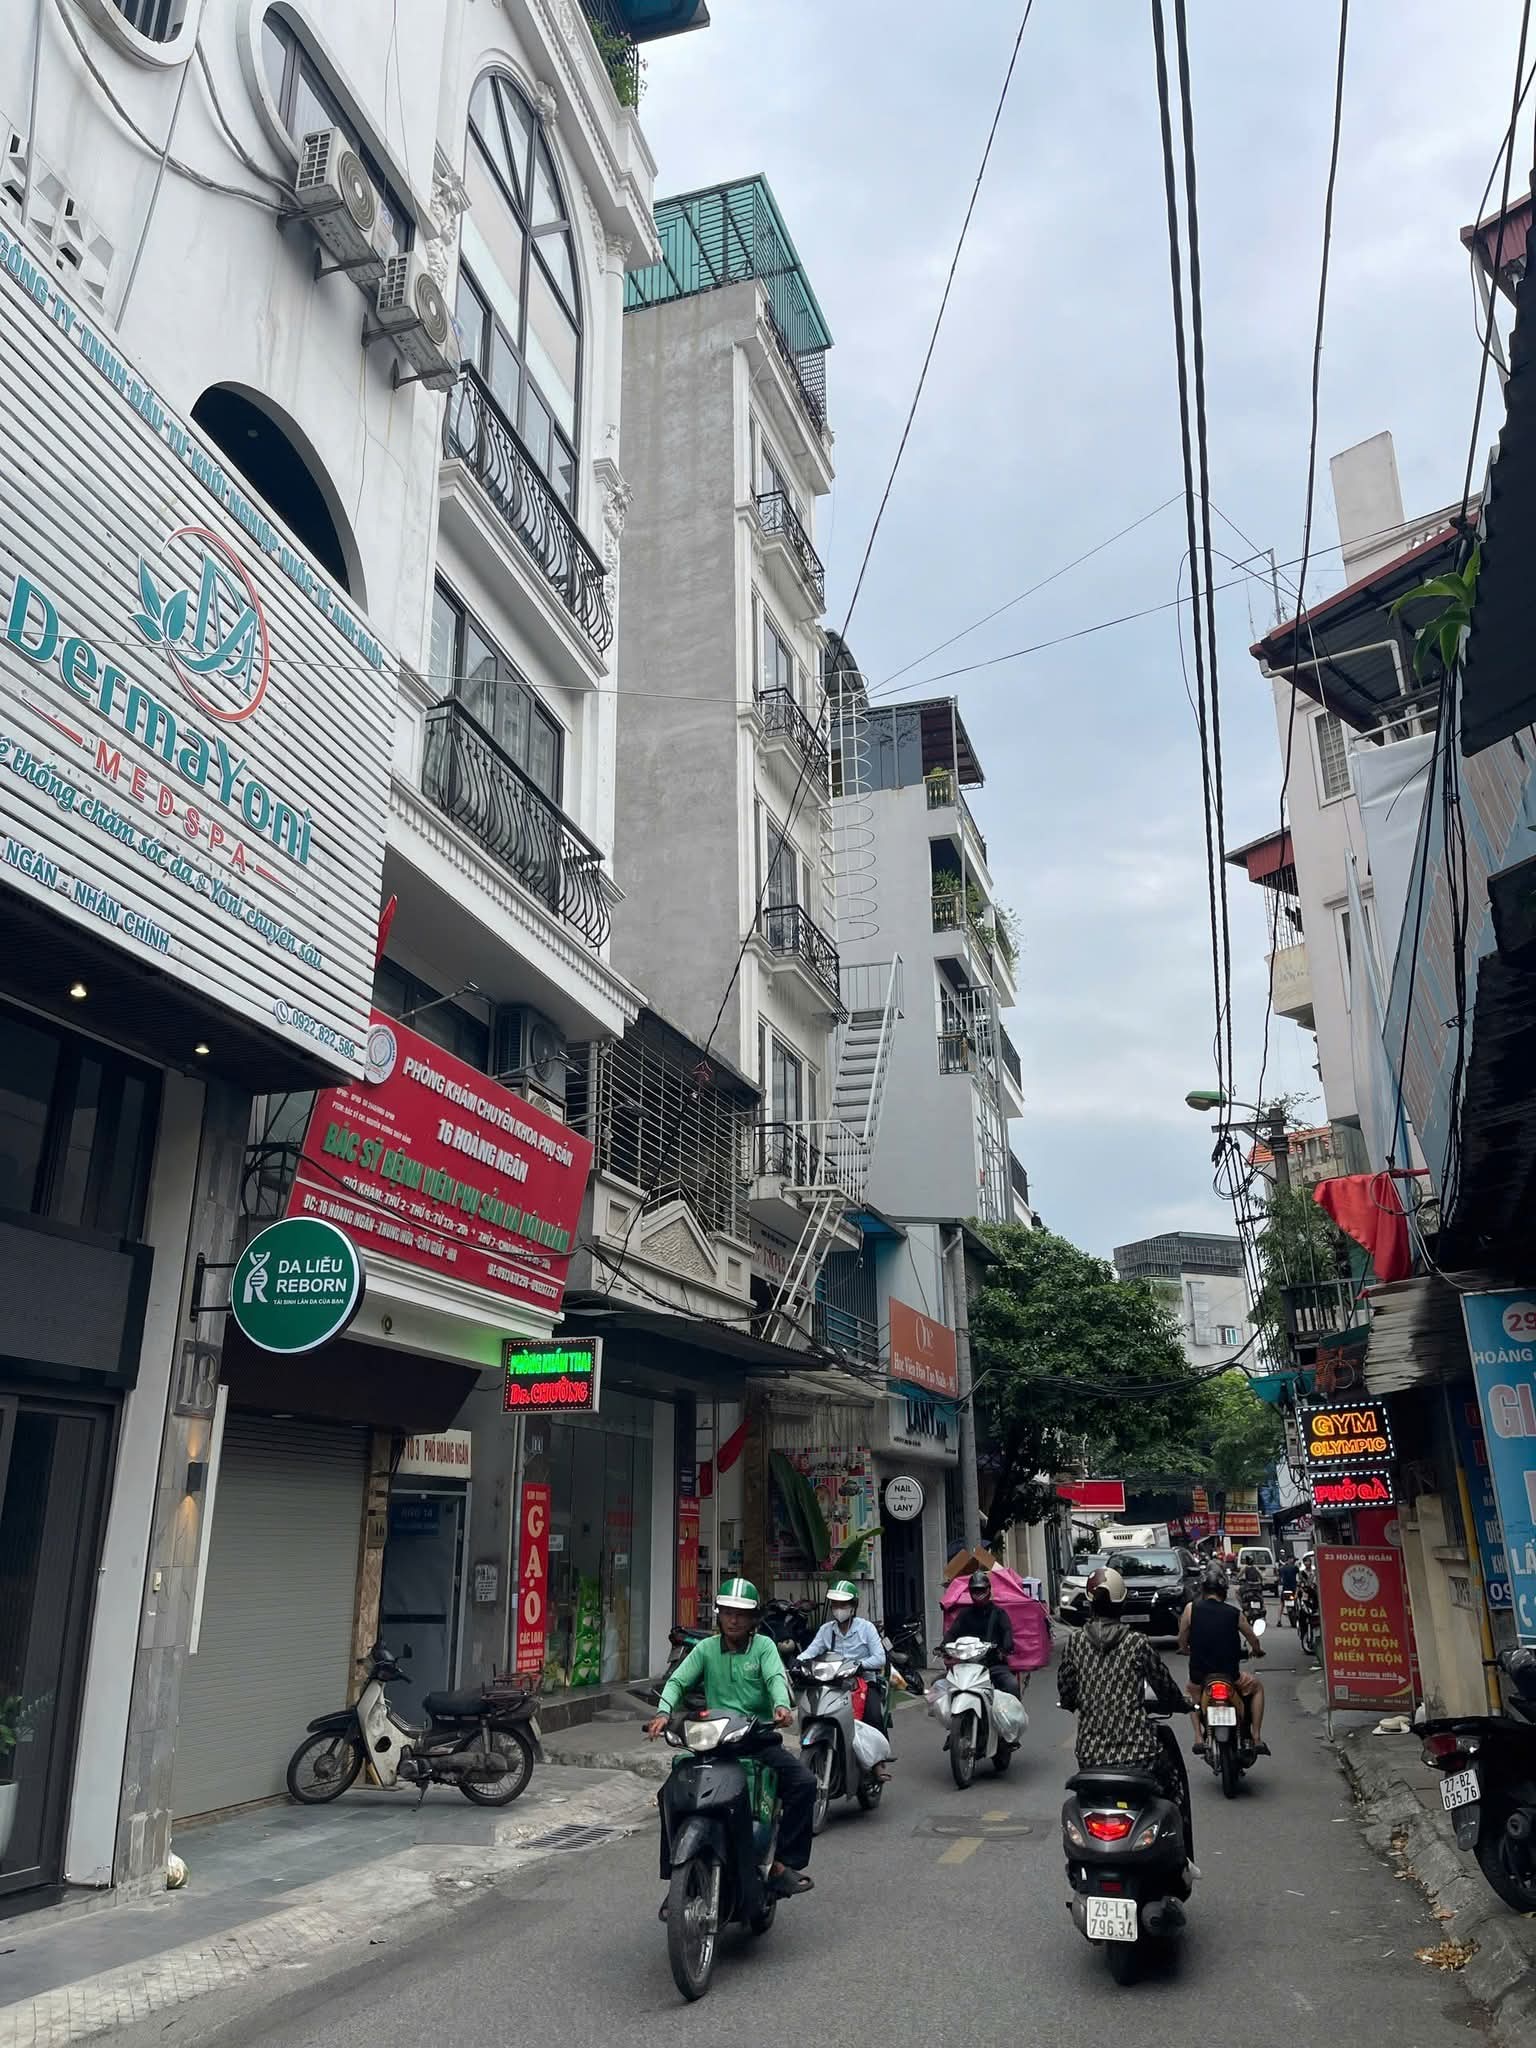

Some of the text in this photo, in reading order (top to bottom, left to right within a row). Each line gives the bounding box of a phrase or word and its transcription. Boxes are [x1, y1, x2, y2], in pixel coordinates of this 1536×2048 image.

[53, 293, 76, 333] TY
[81, 324, 128, 393] TNHH
[229, 491, 279, 554] NGHIỆP
[7, 573, 313, 865] DermaYoni
[12, 745, 77, 812] thống
[80, 795, 135, 847] chăm
[138, 837, 168, 868] sóc
[170, 852, 193, 883] da
[209, 876, 244, 920] Yoni
[297, 942, 323, 971] sâu
[6, 837, 59, 889] NGÂN
[72, 878, 120, 926] NHÂN
[123, 911, 171, 955] CHÍNH
[402, 1056, 446, 1095] PHÒNG
[444, 1079, 478, 1114] KHÁM
[476, 1097, 516, 1135] CHUYÊN
[514, 1118, 538, 1149] KHOA
[537, 1134, 557, 1162] PHỤ
[437, 1117, 454, 1147] 16
[452, 1125, 498, 1169] HOÀNG
[495, 1148, 529, 1184] NGÂN
[321, 1121, 361, 1164] BÁC
[421, 1166, 456, 1206] VIỆN
[278, 1255, 343, 1275] DA LIỄU
[276, 1278, 347, 1294] REBORN
[1473, 1346, 1533, 1365] HOÀNG
[179, 1352, 217, 1409] 18
[1312, 1410, 1378, 1437] GYM
[1310, 1436, 1387, 1457] OLYMPIC
[894, 1484, 913, 1493] NAIL
[1314, 1476, 1389, 1503] PHỞ GÀ
[893, 1504, 913, 1512] LANY
[1340, 1604, 1388, 1619] PHỞ GÀ
[1340, 1621, 1391, 1634] CƠM GÀ
[1334, 1633, 1399, 1650] PHỞ TRỘN
[1332, 1648, 1403, 1667] MIẾN TRỘN
[1444, 1772, 1471, 1793] 27-B2
[1444, 1786, 1477, 1808] 035.76
[1094, 1902, 1129, 1920] 29-L1
[1090, 1918, 1134, 1938] 796.34
